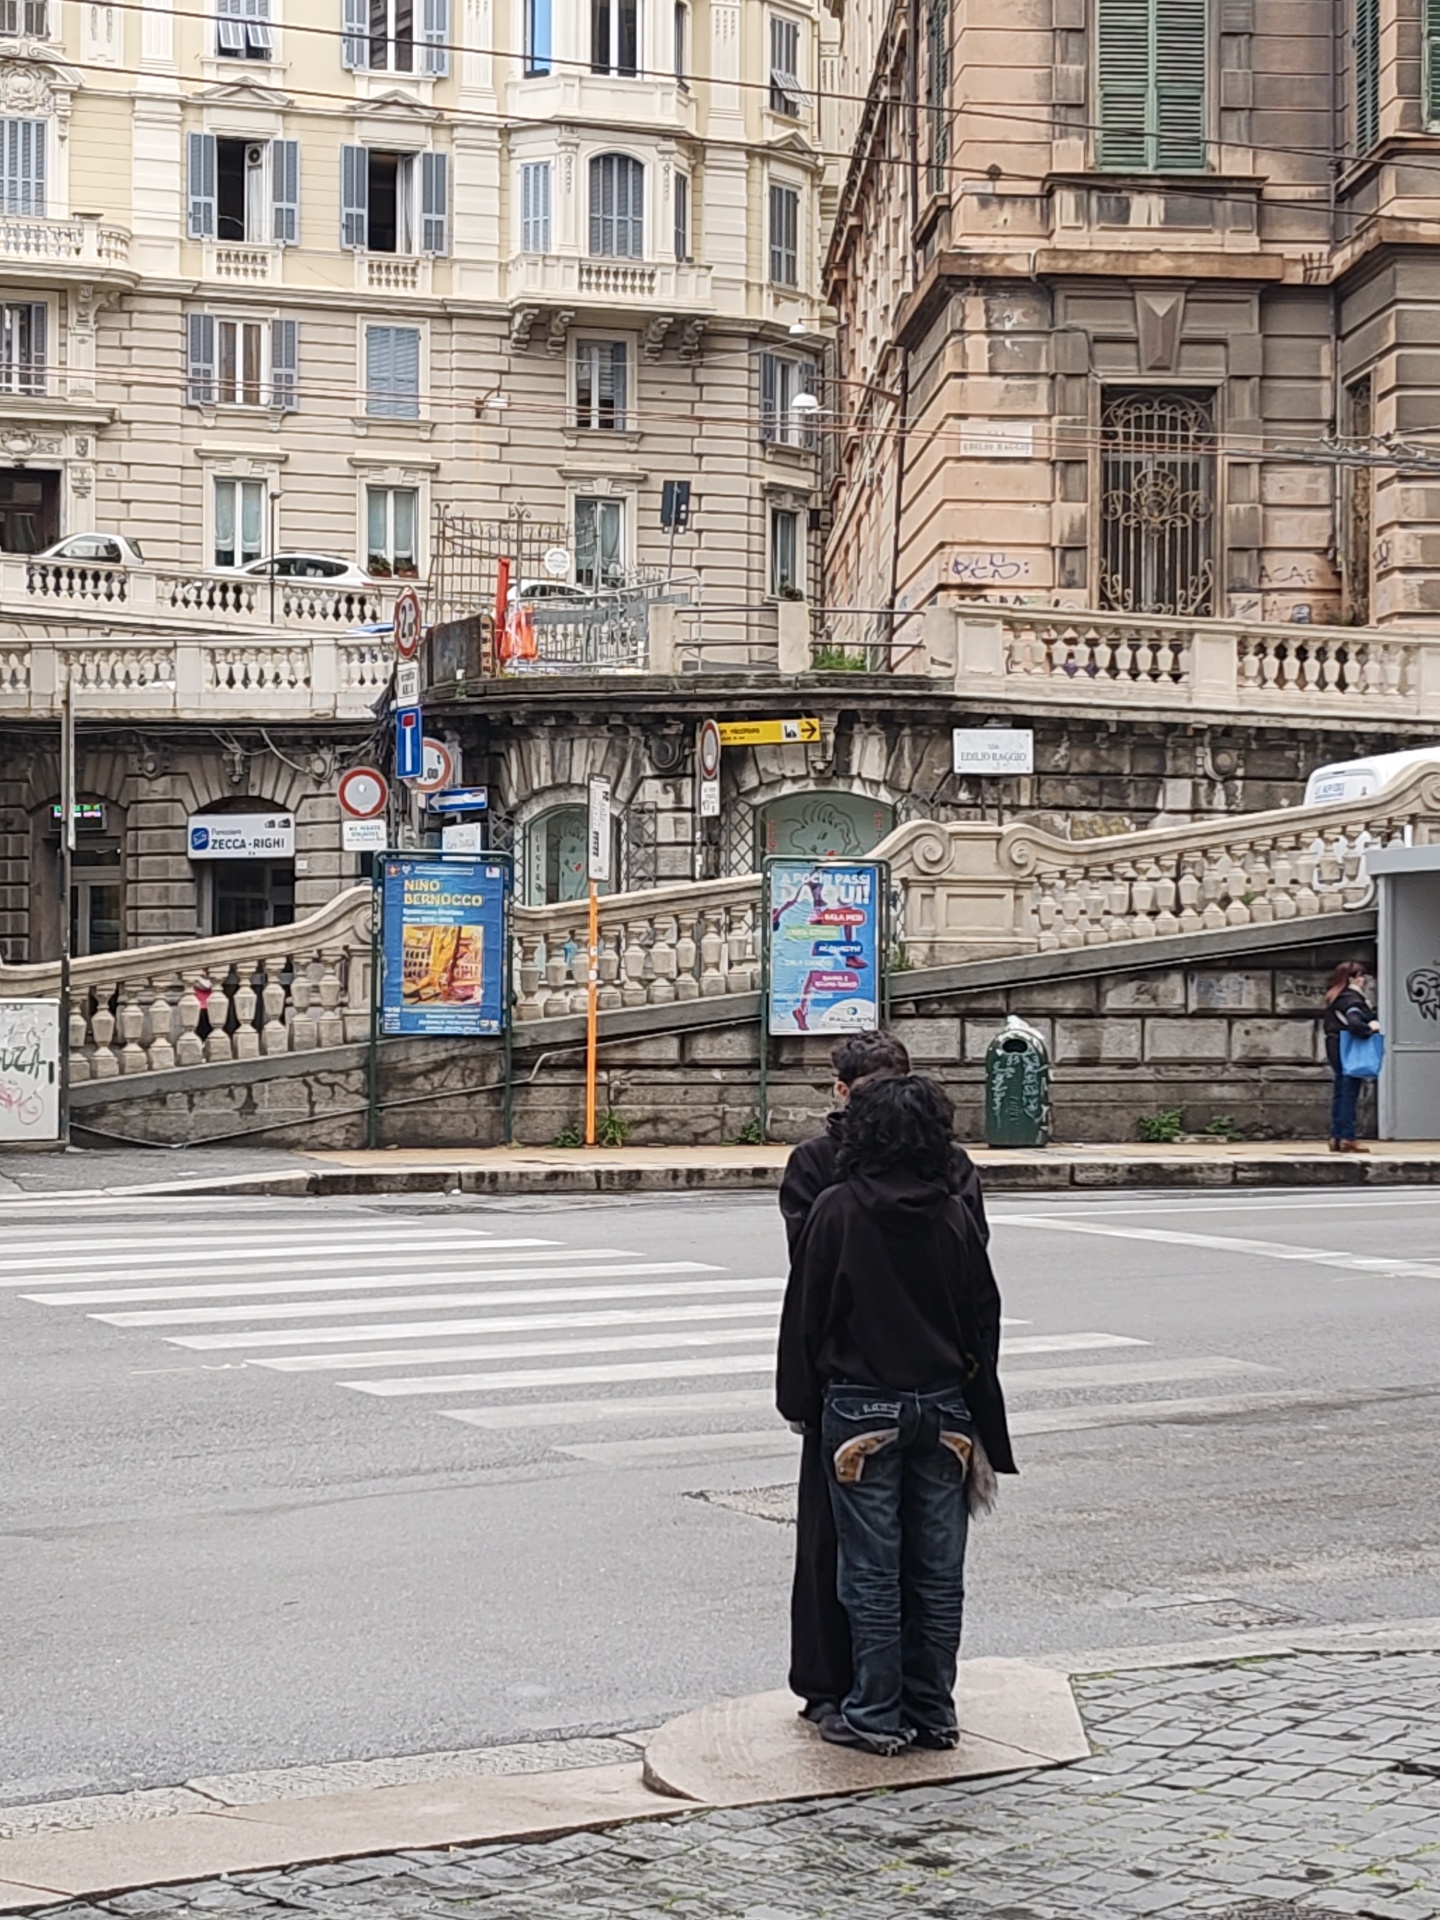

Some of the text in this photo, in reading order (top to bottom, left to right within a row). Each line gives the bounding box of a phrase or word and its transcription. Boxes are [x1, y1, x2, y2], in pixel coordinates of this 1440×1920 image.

[960, 752, 1027, 761] EDILIO RAGGIO
[403, 879, 440, 892] NINO
[834, 874, 870, 884] PASSI
[403, 893, 483, 907] BERNOCCO
[780, 885, 870, 909] DA QUI!
